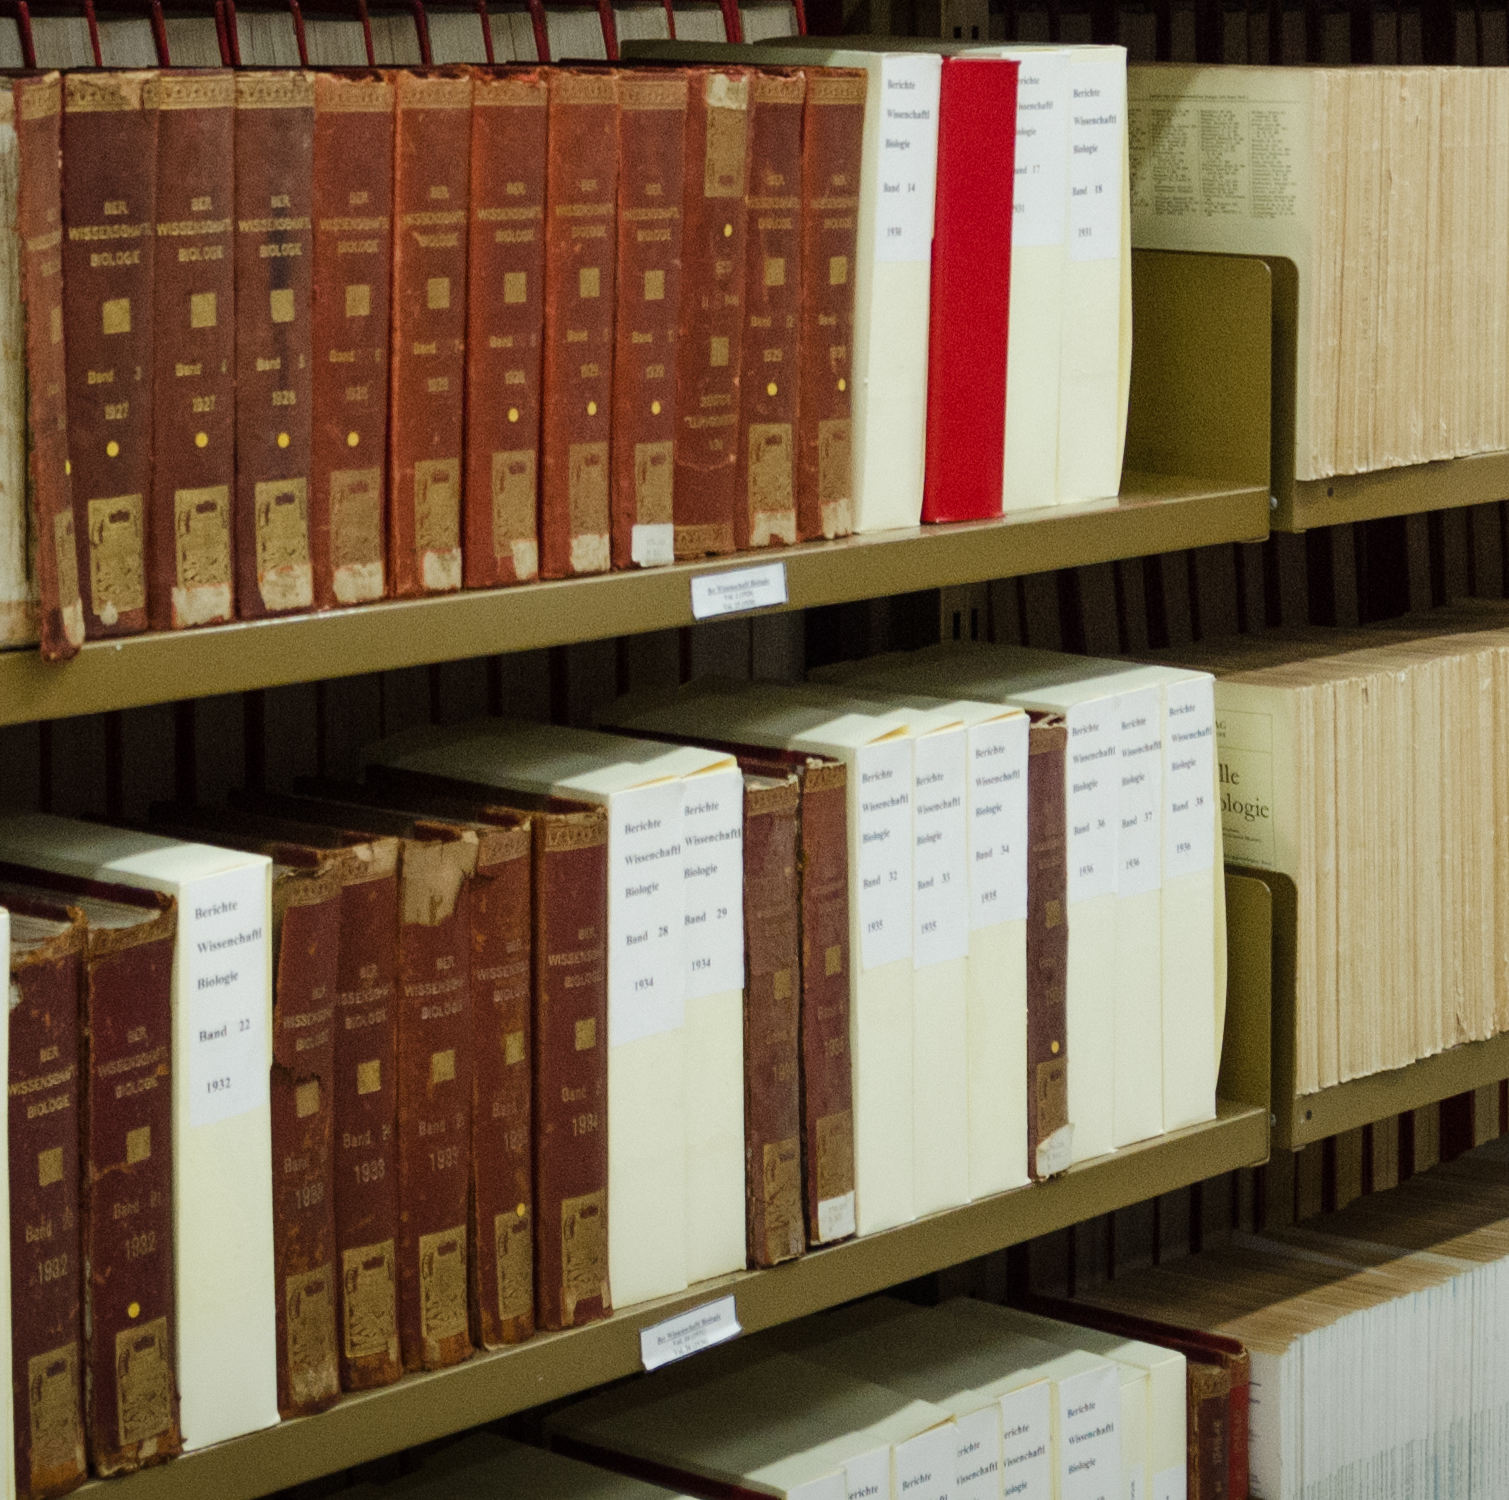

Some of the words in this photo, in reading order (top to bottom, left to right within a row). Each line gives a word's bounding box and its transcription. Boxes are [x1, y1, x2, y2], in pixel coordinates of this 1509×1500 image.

[888, 80, 915, 89] Berichte
[1073, 89, 1100, 98] Berichte
[888, 110, 929, 119] Wissenchaftl
[1074, 115, 1116, 125] Wissenchaftl
[886, 139, 910, 150] Biologie
[1073, 145, 1098, 154] Biologie
[884, 184, 899, 192] Band
[908, 184, 916, 192] 14
[1072, 188, 1087, 196] Band
[1095, 185, 1102, 193] 18
[1169, 705, 1195, 716] Berichte
[1071, 722, 1100, 738] Berichte
[1120, 717, 1147, 731] Berichte
[1171, 726, 1213, 742] Wissenchaftl
[975, 745, 1005, 759] Berichte
[1073, 746, 1116, 763] Wissenchaftl
[1121, 740, 1163, 757] Wissenchaftl
[1171, 758, 1197, 772] Biologie
[863, 771, 892, 782] Berichte
[915, 772, 944, 787] Berichte
[975, 769, 1020, 787] Wissenchaftl
[1121, 773, 1145, 787] Biologie
[1072, 779, 1098, 793] Biologie
[684, 801, 719, 816] Berichte
[862, 794, 909, 812] Wissenchaftl
[916, 796, 961, 815] Wissenchaftl
[975, 803, 1003, 817] Biologie
[1172, 802, 1188, 812] Band
[1196, 797, 1204, 805] 38
[624, 819, 662, 835] Berichte
[1122, 818, 1137, 828] Band
[1144, 811, 1153, 821] 37
[862, 829, 891, 843] Biologie
[1074, 824, 1089, 834] Band
[683, 829, 742, 848] Wissenchaftl
[916, 832, 943, 846] Biologie
[625, 844, 682, 865] Wissenchaftl
[976, 849, 992, 860] Band
[1001, 844, 1010, 854] 34
[1176, 842, 1191, 853] 1936
[1079, 864, 1094, 876] 1936
[1126, 858, 1140, 869] 1936
[683, 864, 718, 879] Biologie
[864, 876, 880, 888] Band
[918, 878, 934, 889] Band
[624, 882, 660, 899] Biologie
[982, 890, 997, 902] 1935
[194, 901, 238, 920] Berichte
[683, 911, 707, 926] Band
[717, 908, 727, 918] 29
[868, 919, 884, 932] 1935
[921, 920, 937, 933] 1935
[196, 929, 262, 953] Wissenchaftl
[625, 930, 649, 946] Band
[659, 926, 668, 937] 28
[692, 959, 711, 970] 1934
[196, 971, 239, 991] Biologie
[635, 978, 654, 990] 1934
[198, 1024, 228, 1043] Band
[240, 1019, 250, 1031] 22
[206, 1076, 231, 1094] 1932
[1066, 1402, 1096, 1419] Berichte
[1002, 1424, 1030, 1440] erichte
[1068, 1422, 1116, 1446] Wissenchaftl
[1067, 1457, 1098, 1476] Biologie
[900, 1472, 933, 1492] Berichte
[1002, 1480, 1029, 1498] iologie
